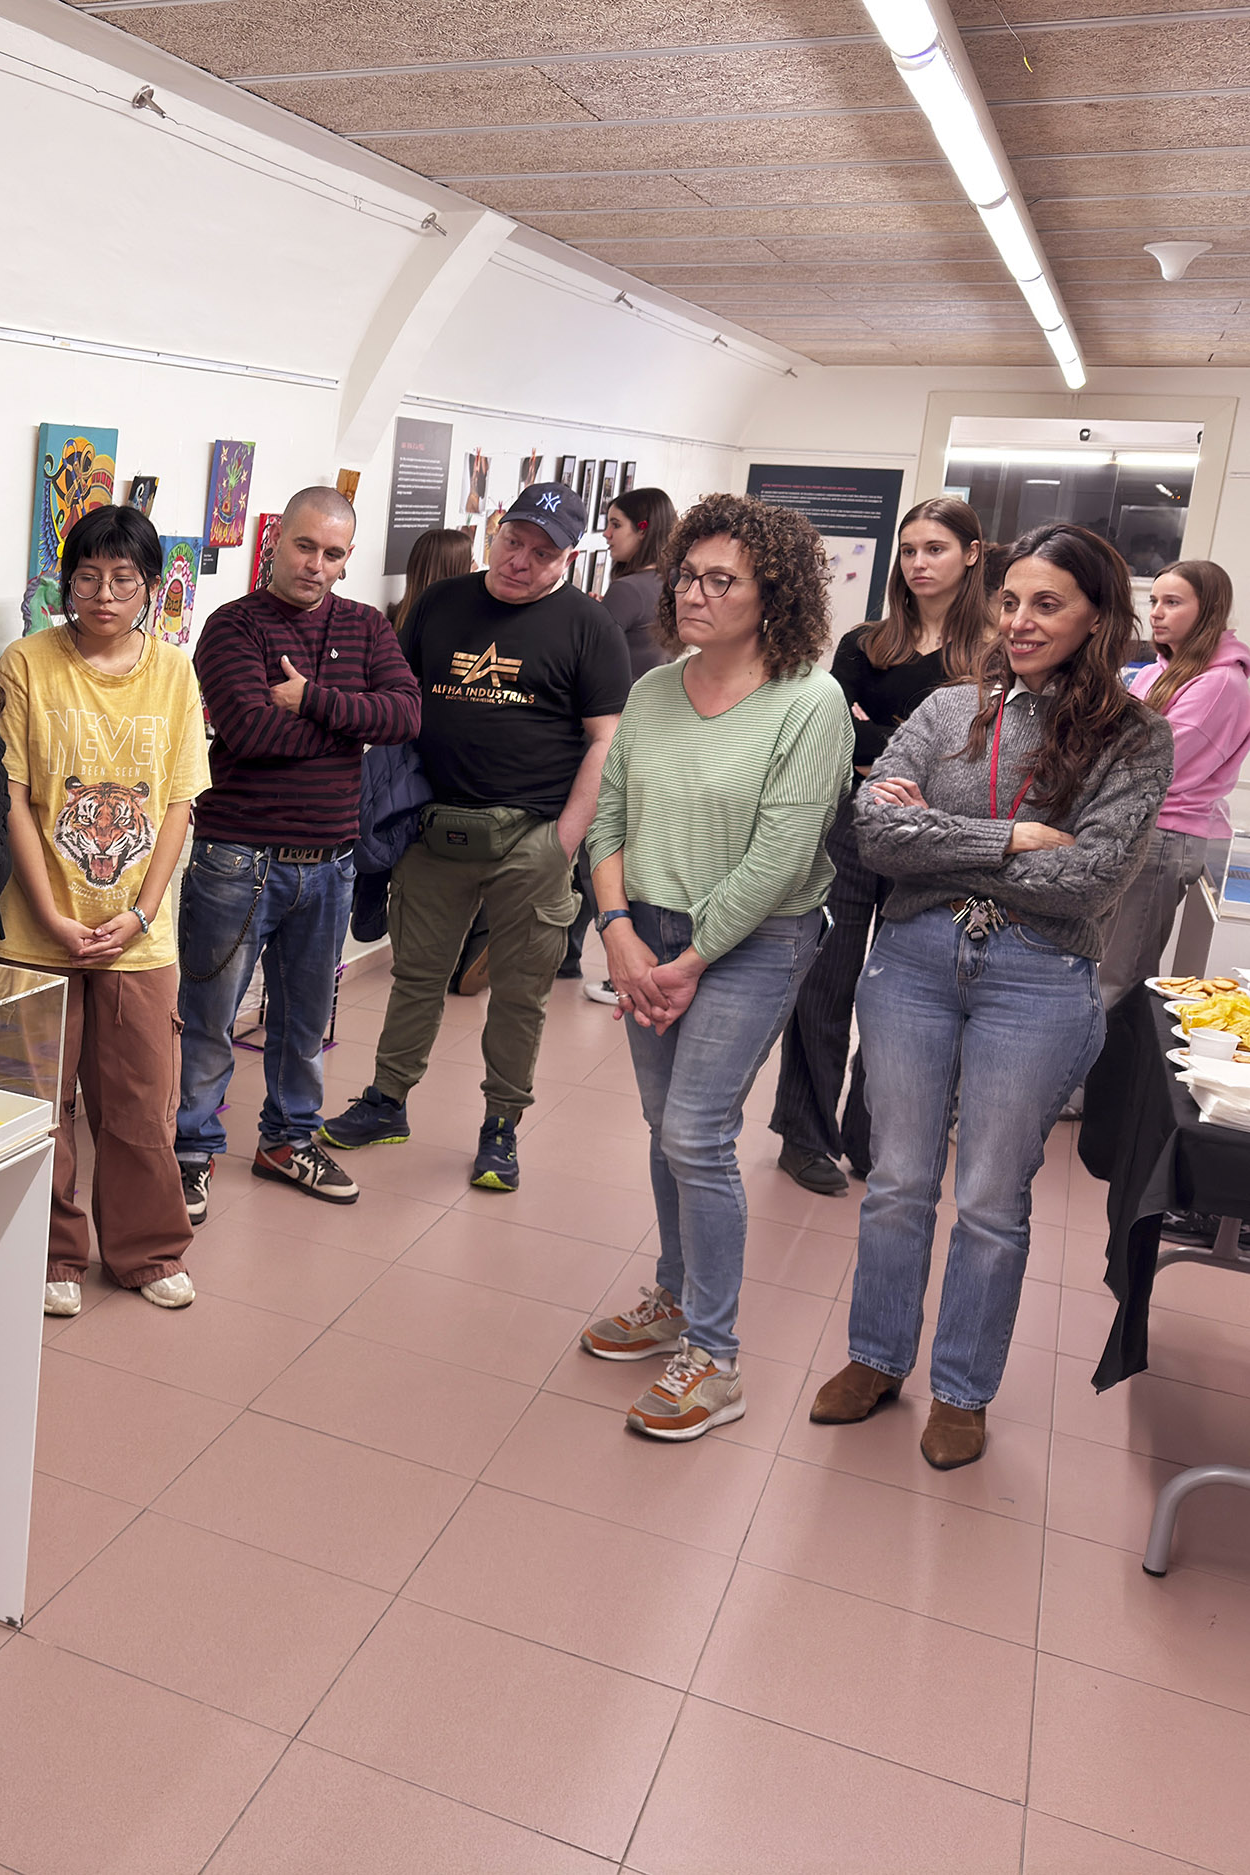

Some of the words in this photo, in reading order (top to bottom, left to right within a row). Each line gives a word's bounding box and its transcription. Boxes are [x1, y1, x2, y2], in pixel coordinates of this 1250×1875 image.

[536, 492, 562, 513] NY
[466, 687, 535, 704] INDUSTRIES
[46, 709, 172, 785] NEVER
[81, 764, 106, 776] BEEN
[115, 766, 140, 777] SEEN
